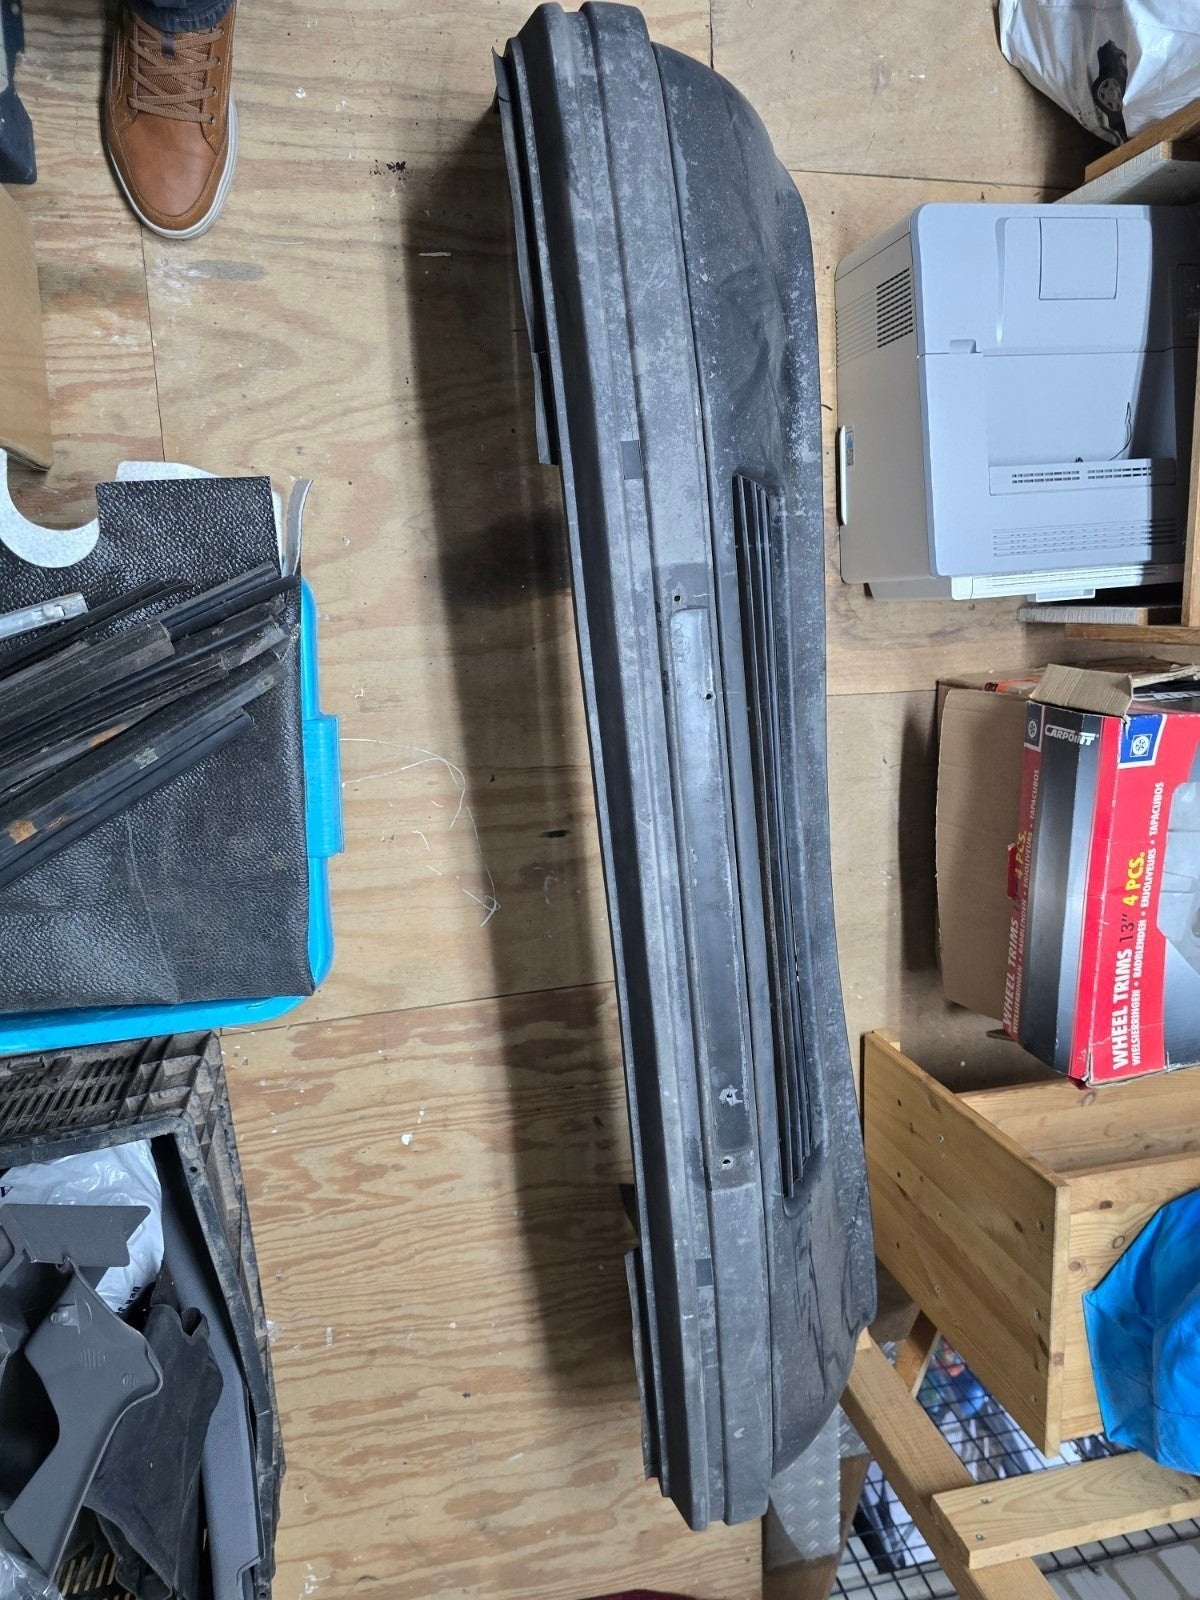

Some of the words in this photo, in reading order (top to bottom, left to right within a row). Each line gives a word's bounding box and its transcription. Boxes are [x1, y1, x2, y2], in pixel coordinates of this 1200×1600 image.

[1149, 781, 1165, 836] TAPACUBOS
[1014, 868, 1023, 879] 4
[1015, 830, 1026, 865] PCS.
[1125, 851, 1146, 891] PCS.
[1013, 966, 1023, 1034] WIELSIERRINGEN
[1018, 899, 1028, 956] RADBLENDEN
[1023, 832, 1033, 888] ENJOLIVEURS
[1030, 769, 1040, 819] TAPACUBOS
[1123, 894, 1139, 907] 4
[1141, 848, 1157, 908] ENJOLIVEURS
[1007, 917, 1019, 970] TRIMS
[1133, 919, 1147, 979] RADBLENDEN
[1114, 948, 1133, 1002] TRIMS
[1003, 984, 1015, 1027] WHEEL
[1131, 989, 1141, 1066] WIELSIERRINGEN
[1112, 1005, 1129, 1070] WHEEL
